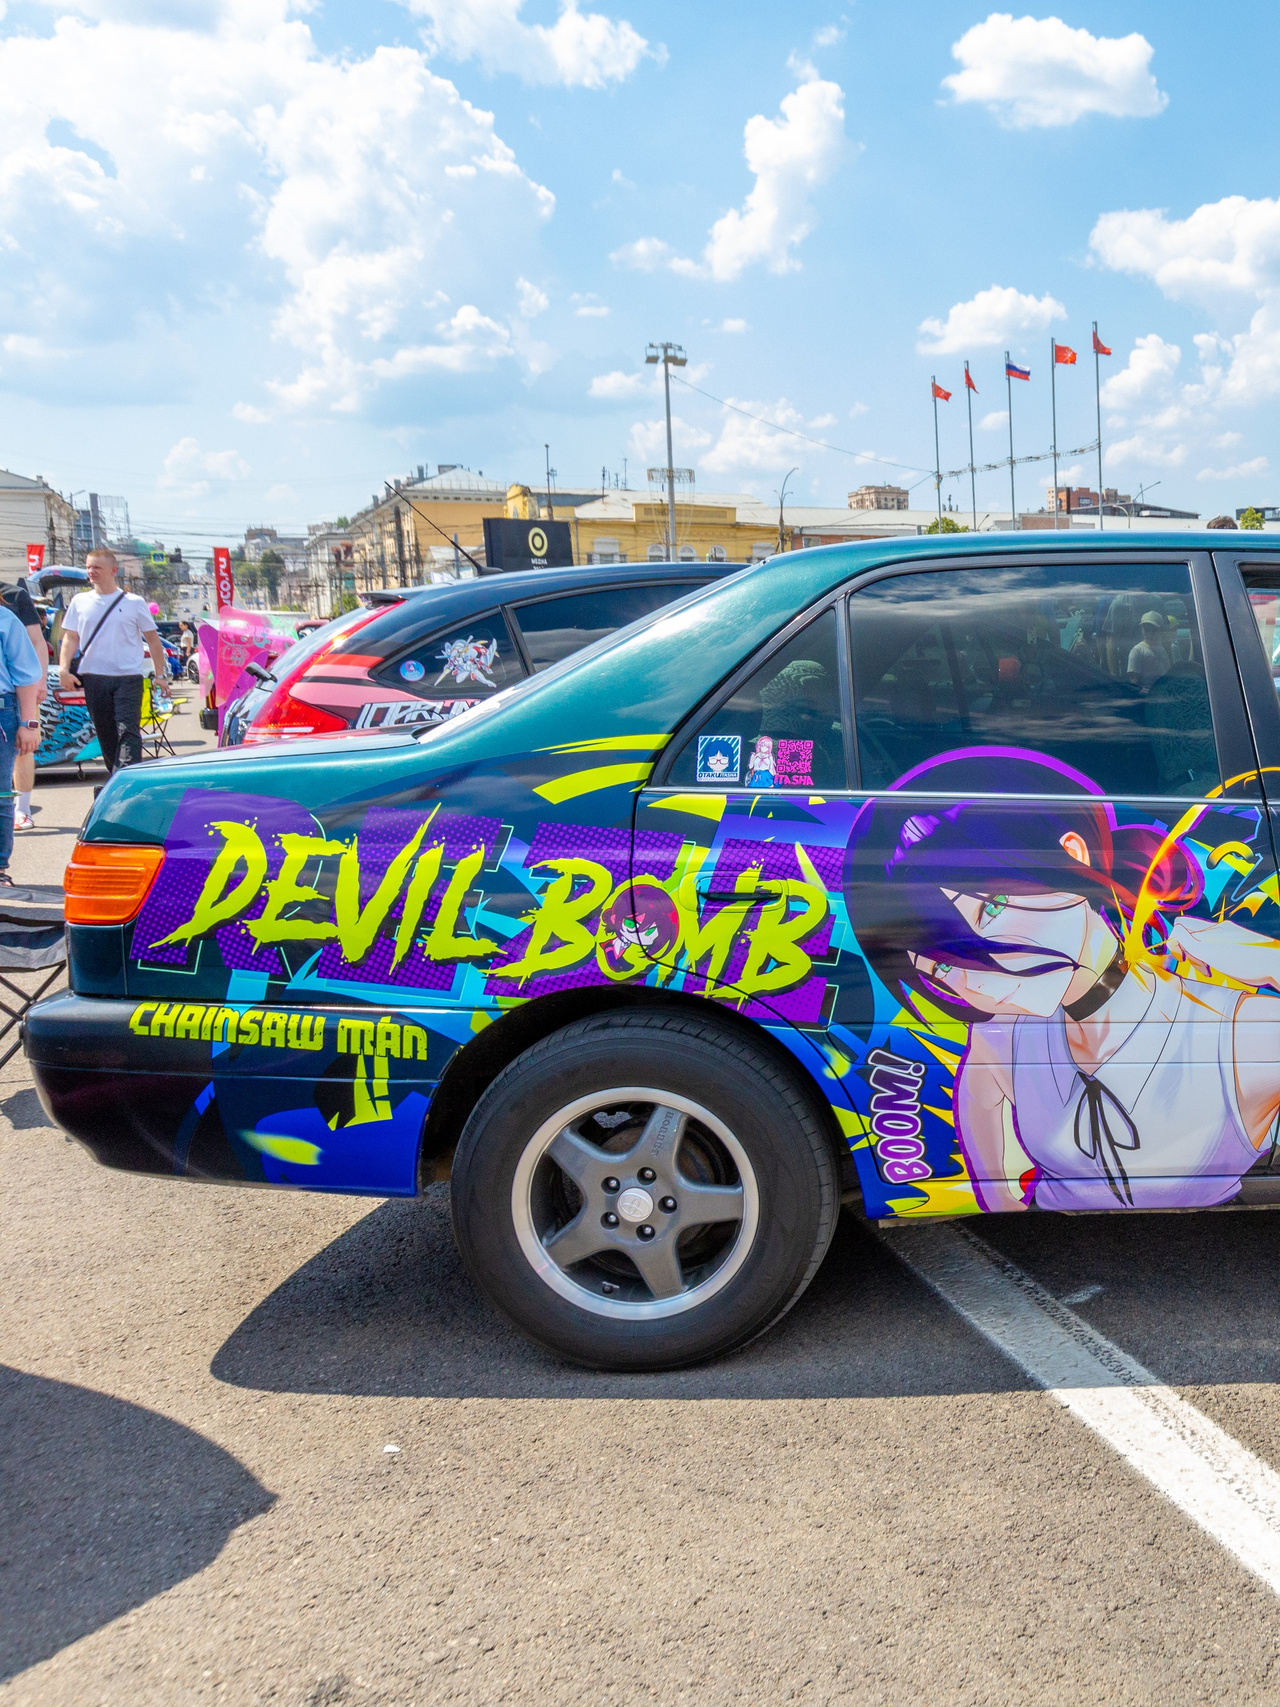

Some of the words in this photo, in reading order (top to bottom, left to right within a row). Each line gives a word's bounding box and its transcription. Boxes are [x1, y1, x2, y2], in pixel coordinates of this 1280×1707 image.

[773, 775, 814, 786] ITASHA
[148, 802, 508, 977] DEVIL
[480, 856, 829, 1001] BOMB
[129, 1001, 327, 1052] CHAINSAW
[868, 1049, 933, 1184] BOOM!
